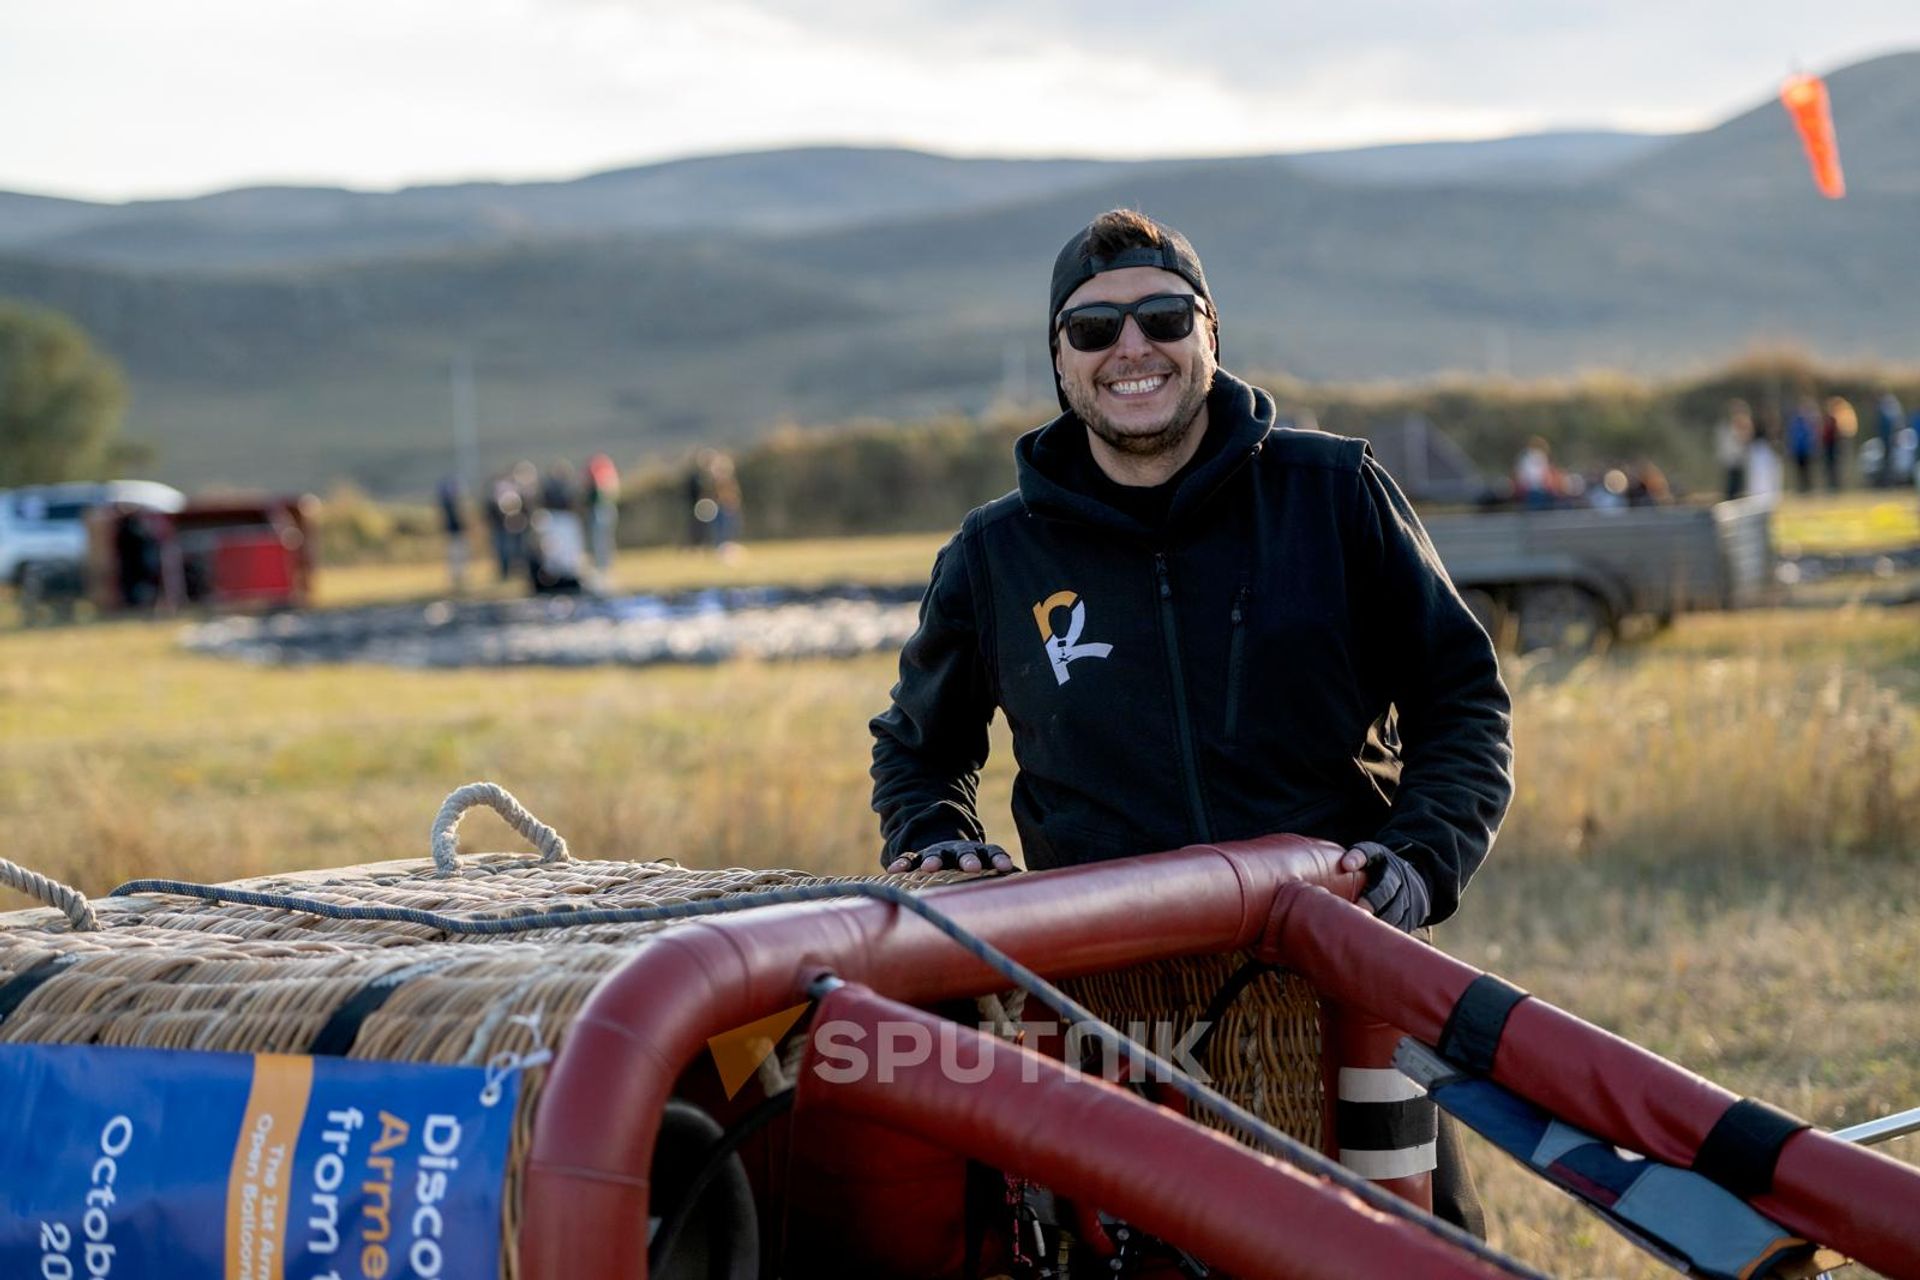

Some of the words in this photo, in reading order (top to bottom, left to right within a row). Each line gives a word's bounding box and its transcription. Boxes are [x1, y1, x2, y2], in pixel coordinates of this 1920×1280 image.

[82, 1114, 133, 1280] Octob
[245, 1113, 274, 1177] Open
[263, 1144, 286, 1188] The
[307, 1106, 364, 1253] from
[409, 1114, 462, 1280] Disco
